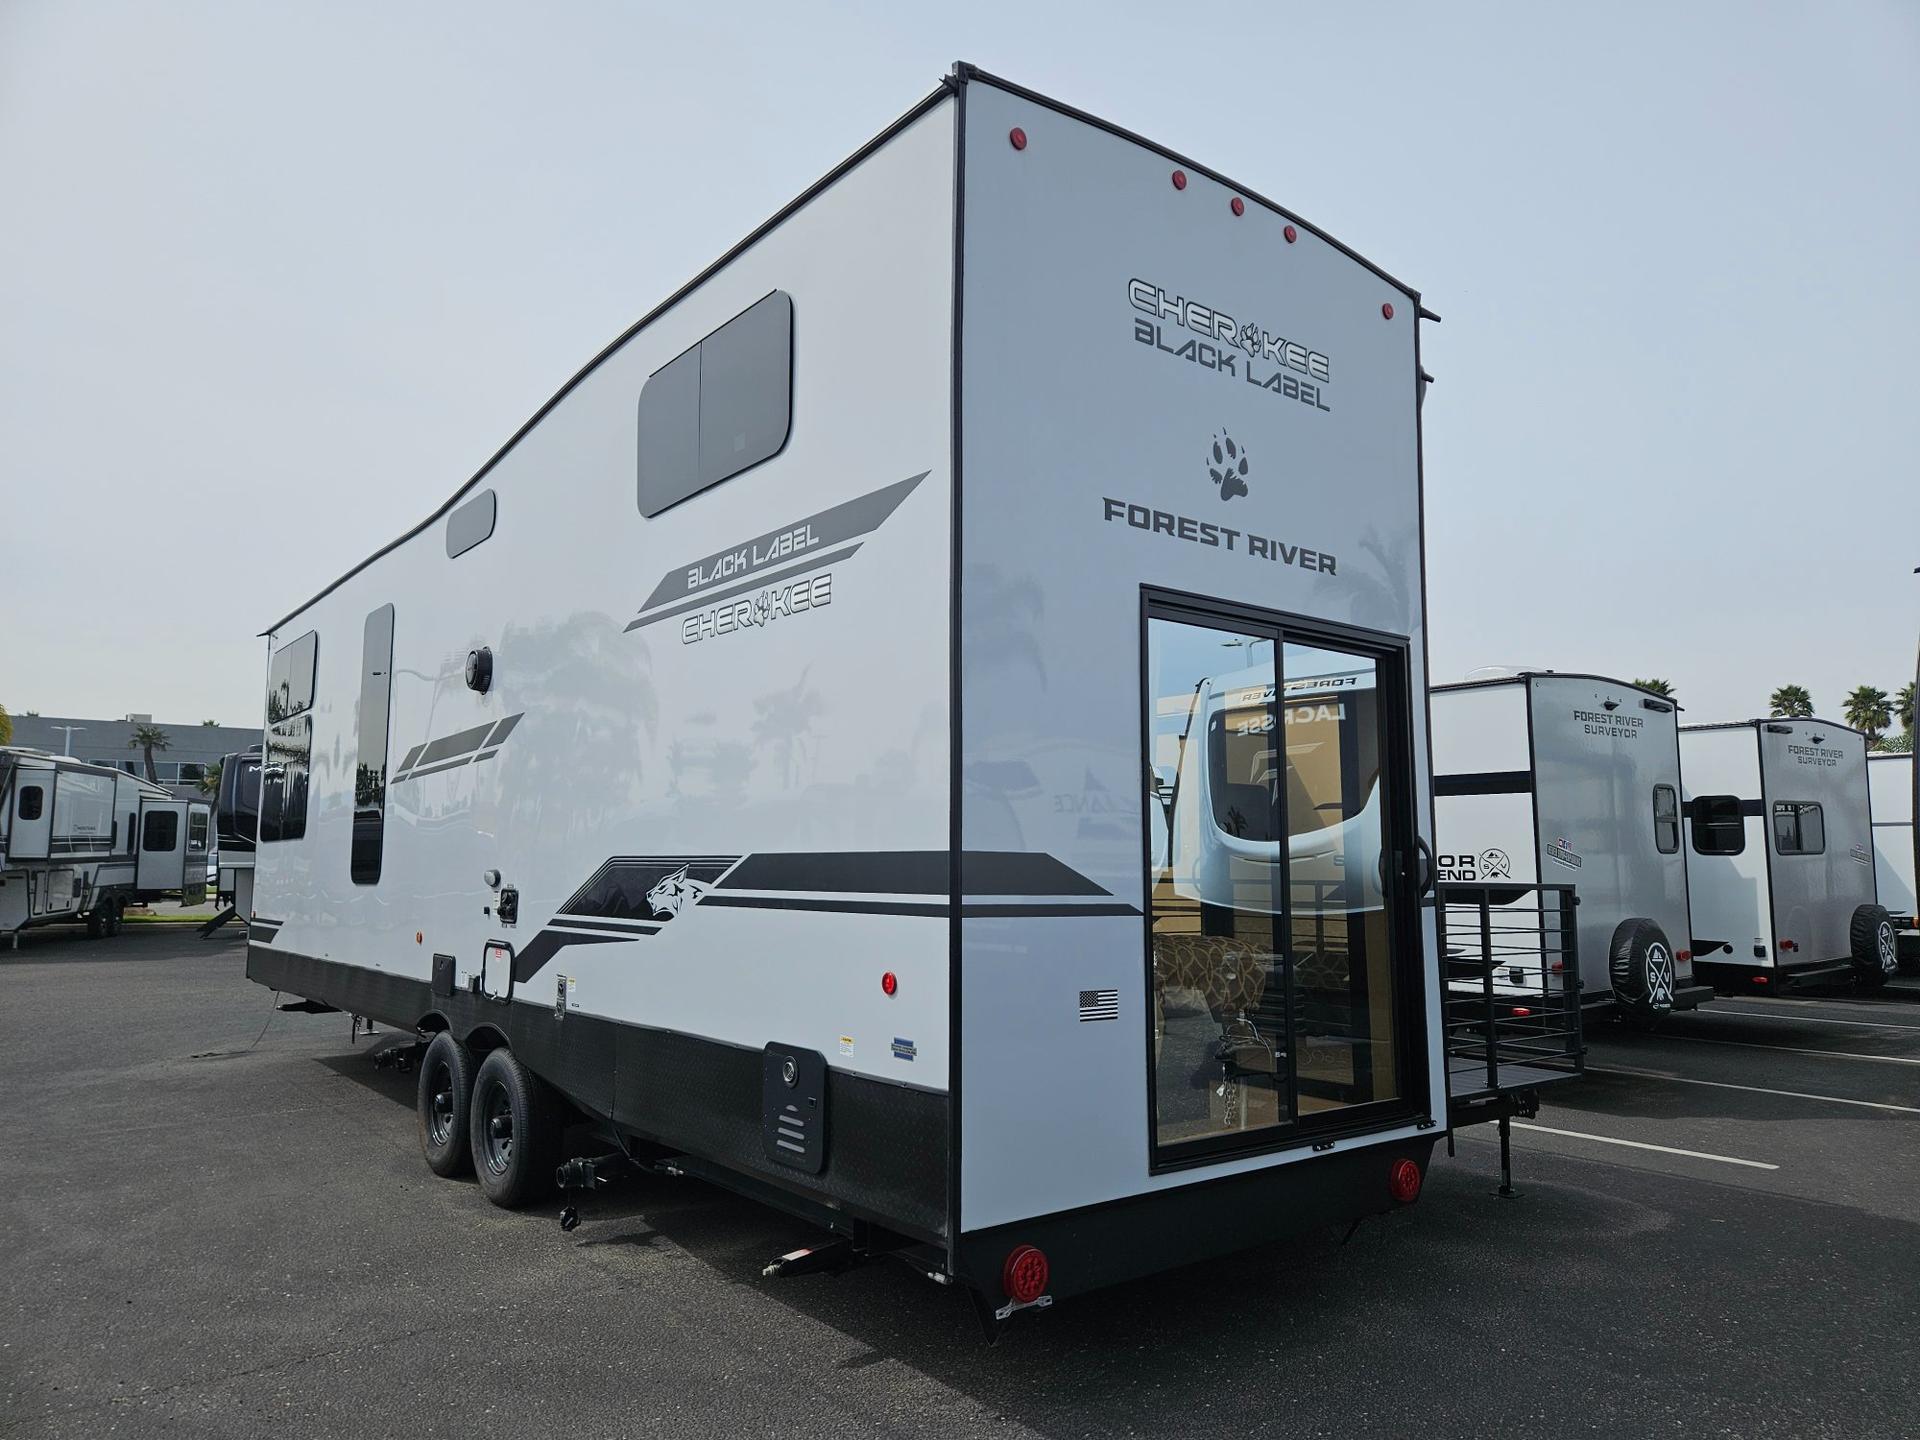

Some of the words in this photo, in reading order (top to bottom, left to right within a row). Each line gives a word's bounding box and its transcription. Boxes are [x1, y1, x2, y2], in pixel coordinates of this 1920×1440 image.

[1134, 317, 1236, 377] BLACK
[1246, 360, 1331, 412] LABEL
[1102, 497, 1241, 551] FOREST
[1247, 533, 1337, 576] RIVER
[687, 548, 748, 590] BLACK
[752, 524, 819, 565] LABEL
[1573, 710, 1613, 725] FOREST
[1615, 715, 1644, 728] RIVER
[1584, 724, 1638, 739] SURVEYOR
[1787, 745, 1819, 756] FOREST
[1820, 749, 1844, 760] RIVER
[1797, 756, 1837, 767] SURVEYOR
